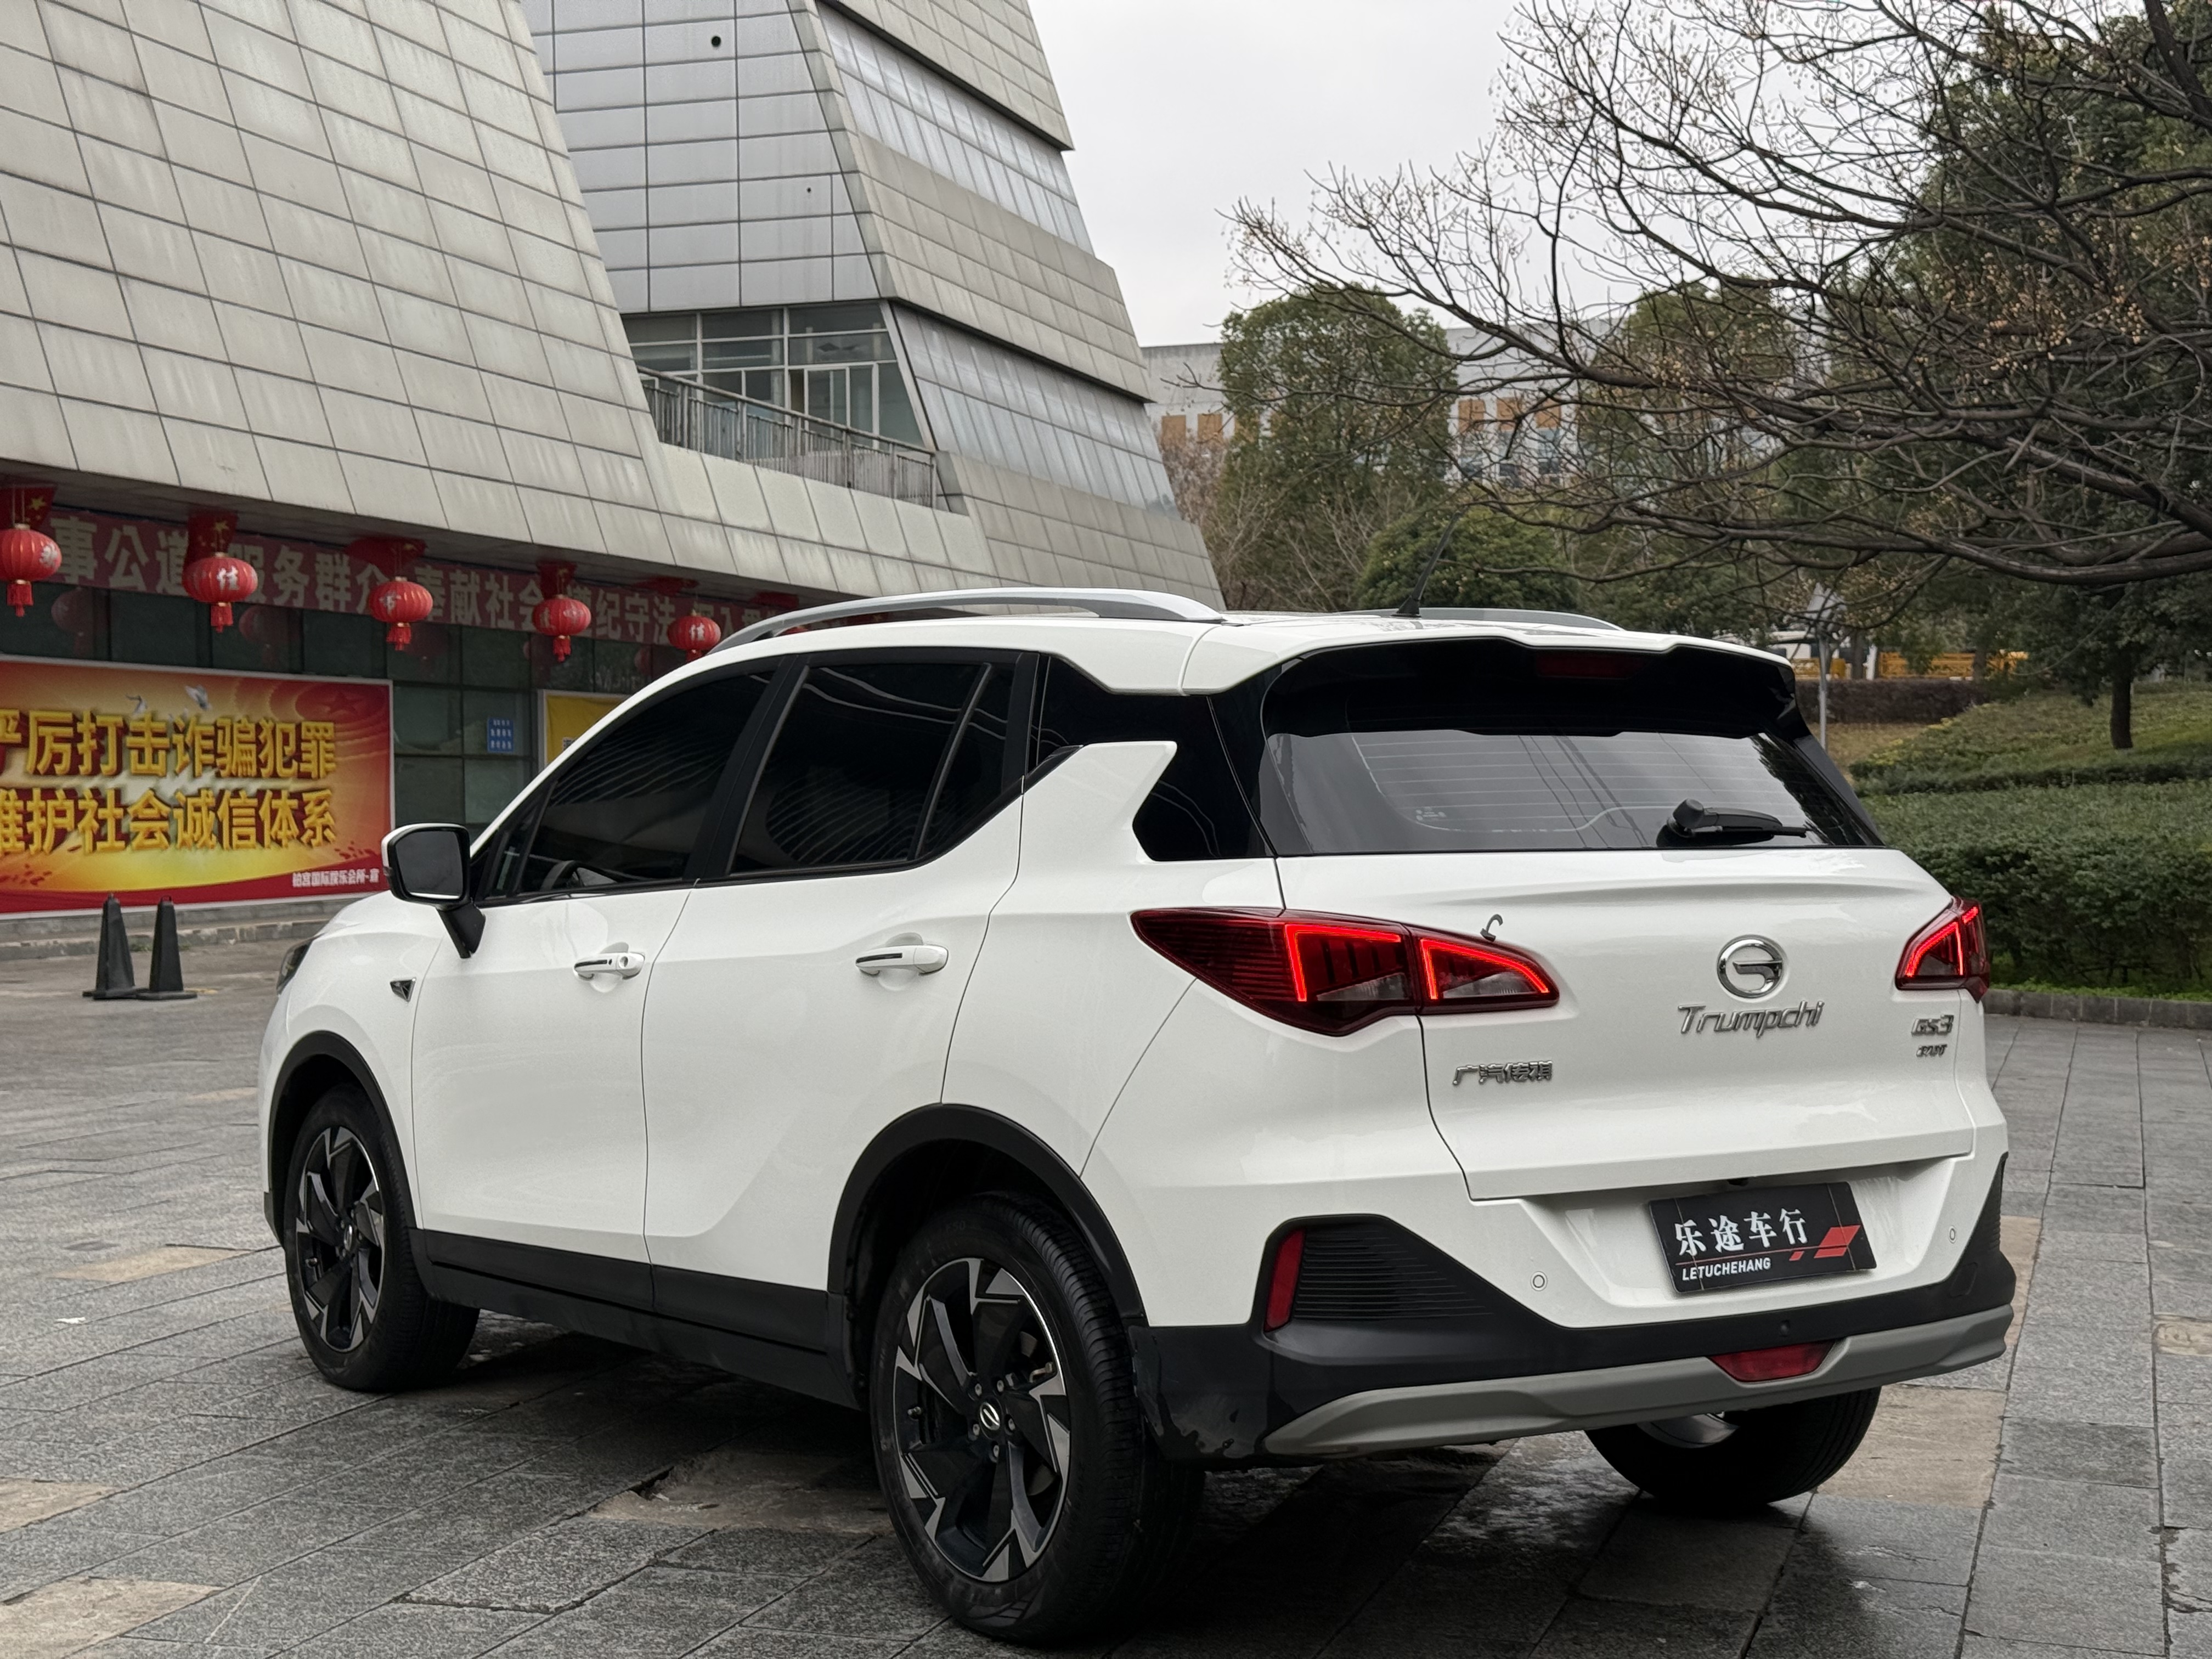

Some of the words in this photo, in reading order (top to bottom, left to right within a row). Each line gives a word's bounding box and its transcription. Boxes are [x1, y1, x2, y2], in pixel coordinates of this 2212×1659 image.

[1678, 1001, 1825, 1038] Trumpchi
[1911, 1014, 1954, 1036] GS3
[1452, 1060, 1553, 1085] 广汽传祺
[1674, 1208, 1808, 1256] 乐途车行
[1682, 1257, 1772, 1282] LETUCHEHANG
